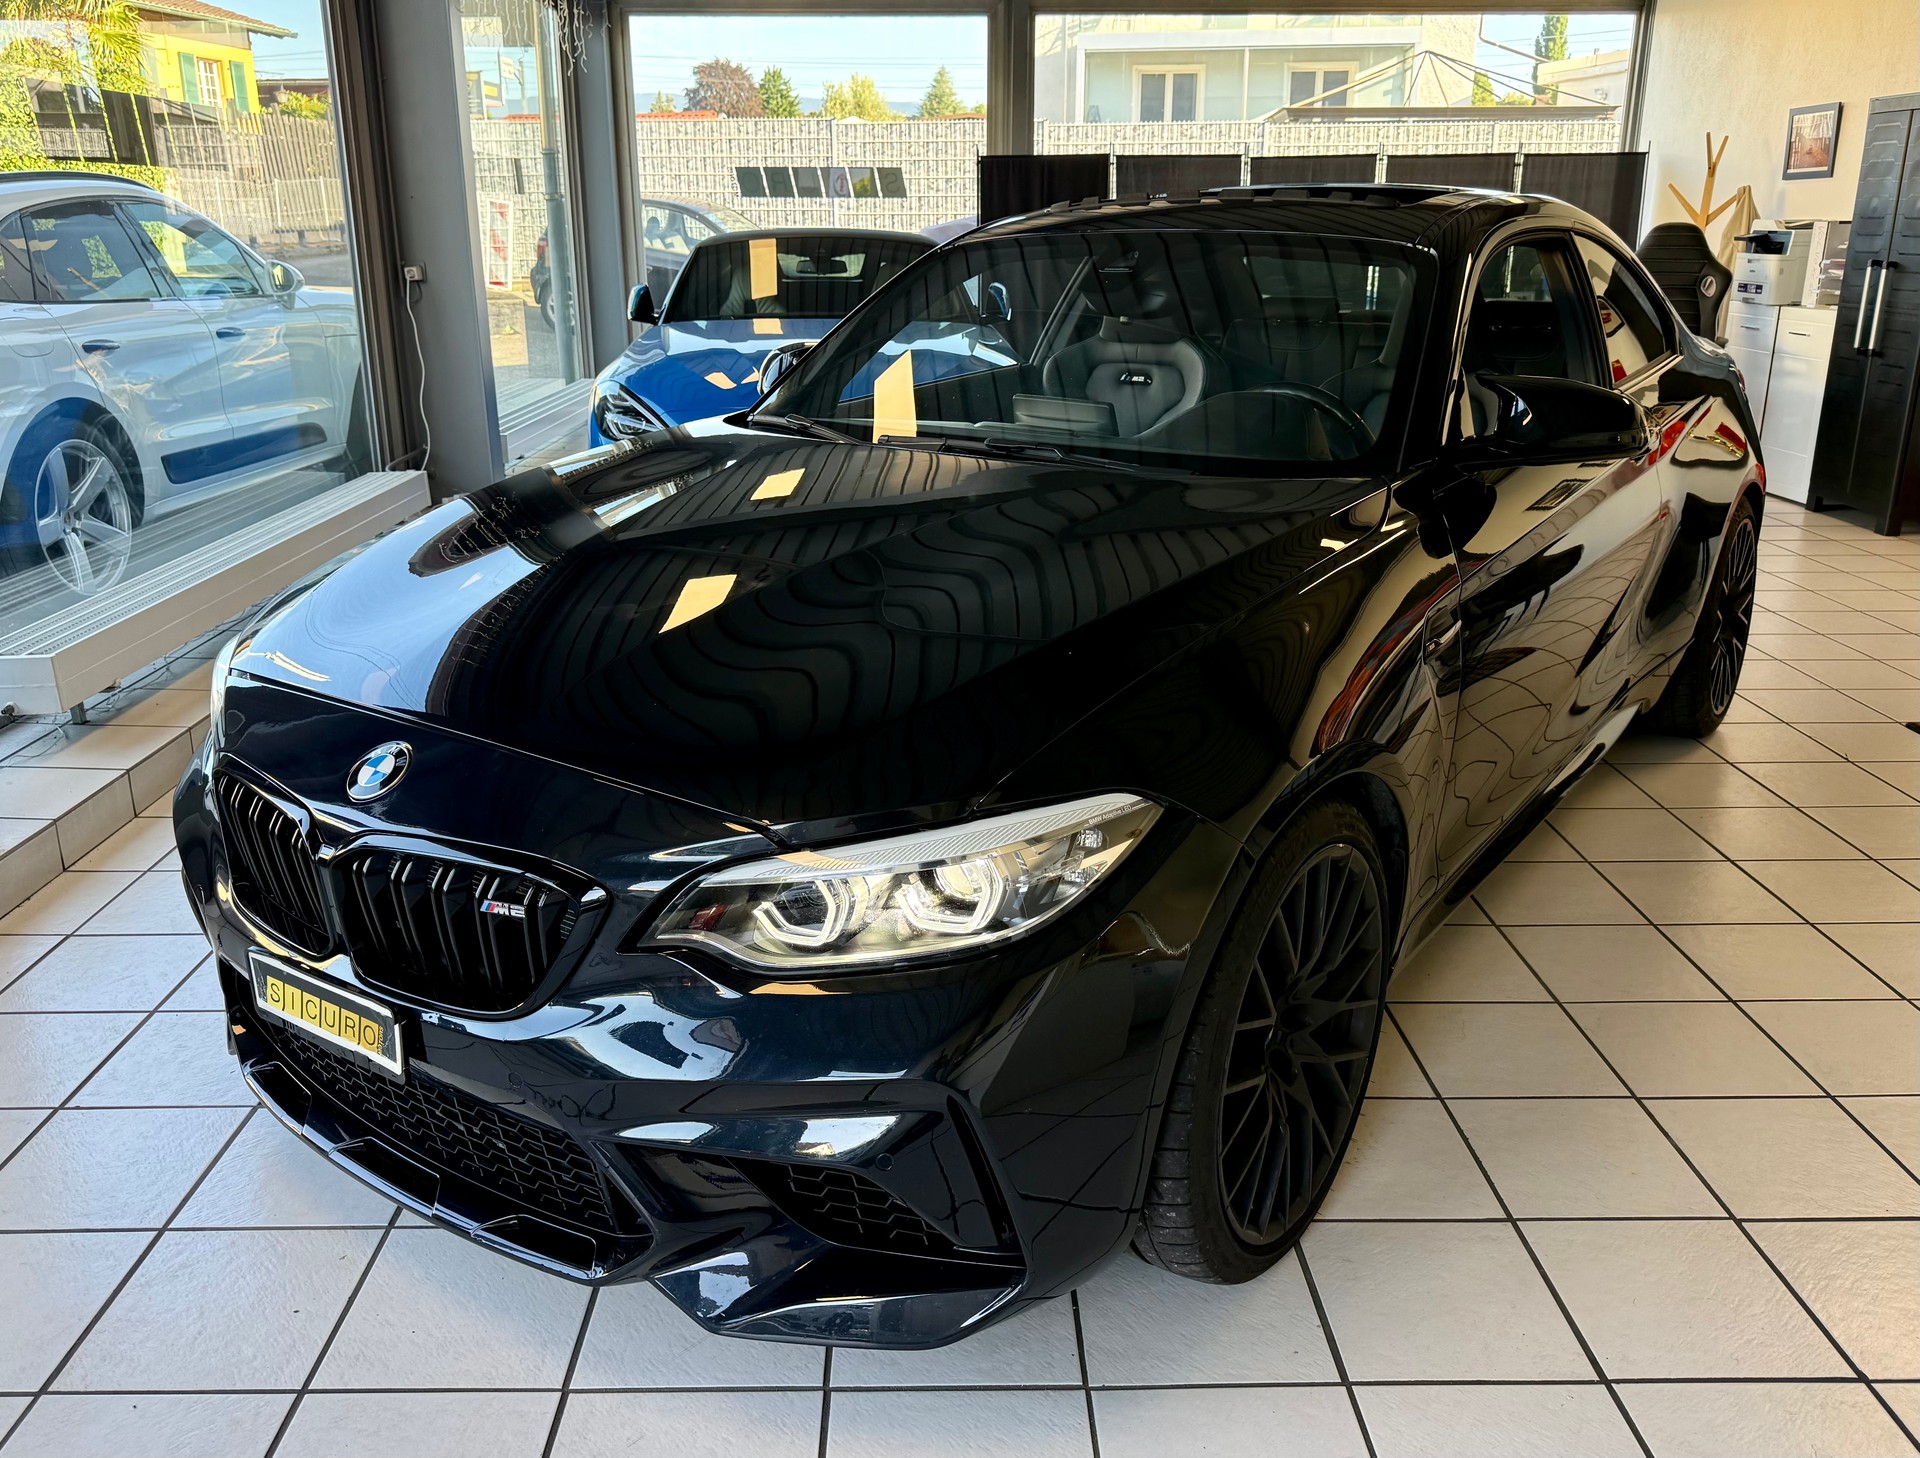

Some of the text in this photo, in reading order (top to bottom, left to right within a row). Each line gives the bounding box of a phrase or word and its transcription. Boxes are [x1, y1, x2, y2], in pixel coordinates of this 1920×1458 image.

[370, 745, 407, 767] BMW
[1088, 804, 1132, 825] BMW Adaptive LED
[493, 902, 526, 918] M2
[270, 982, 376, 1046] SICURO
